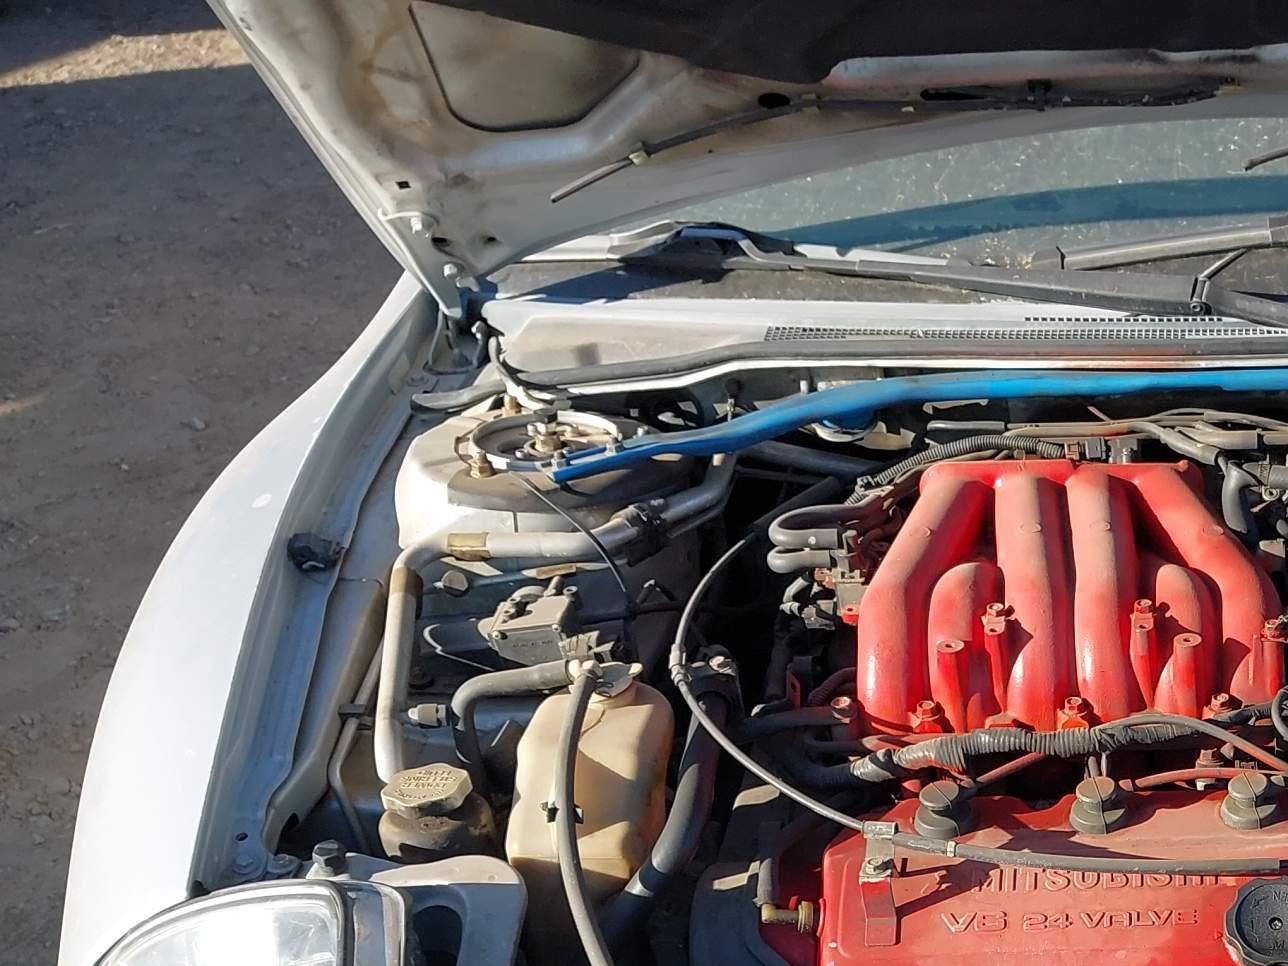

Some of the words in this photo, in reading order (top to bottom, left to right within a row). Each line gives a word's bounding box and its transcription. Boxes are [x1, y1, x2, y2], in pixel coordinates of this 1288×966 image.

[941, 910, 1008, 934] V6
[1022, 912, 1074, 931] 24
[1080, 908, 1199, 929] VALVE
